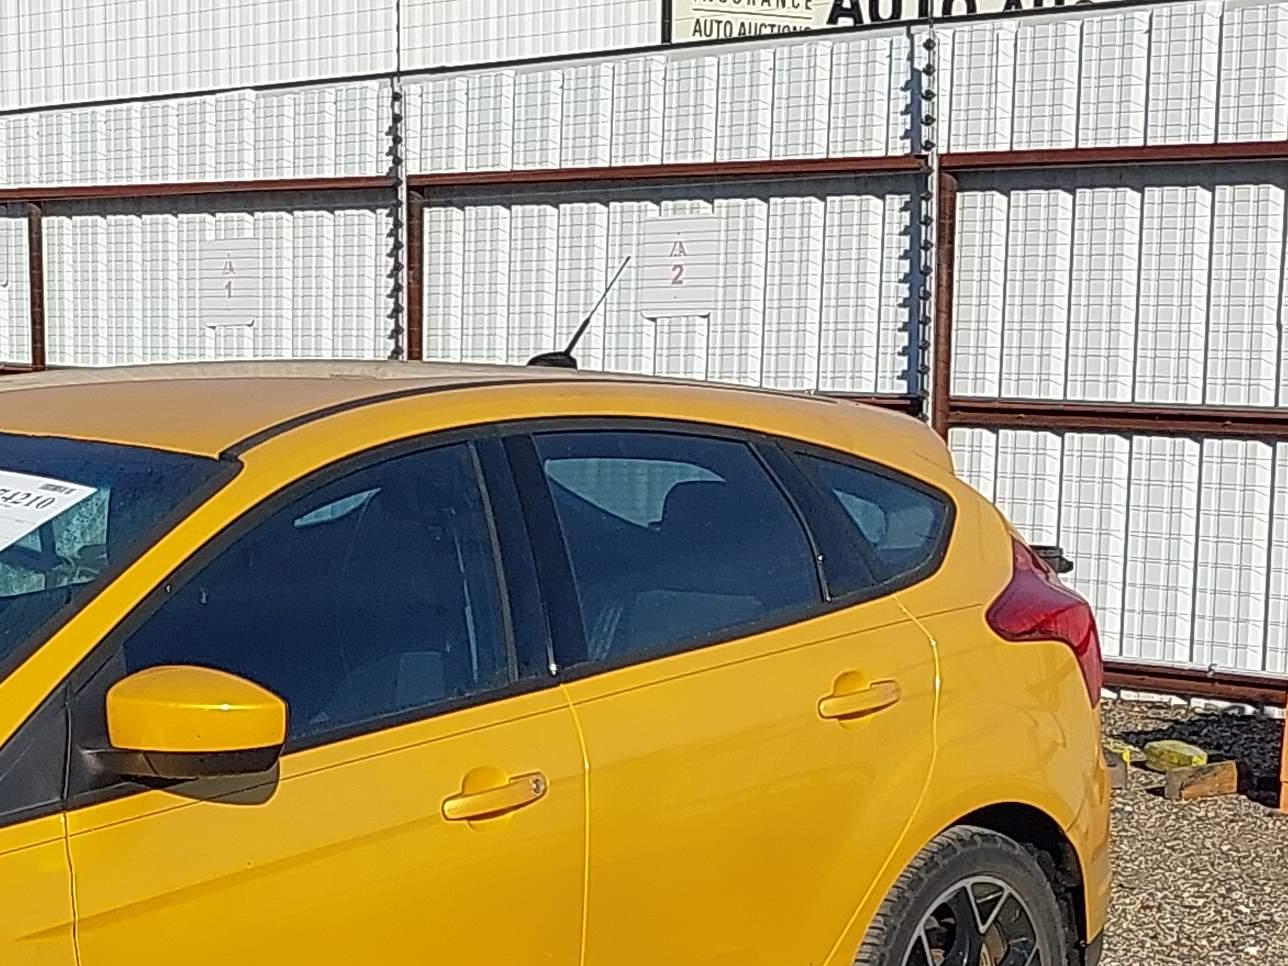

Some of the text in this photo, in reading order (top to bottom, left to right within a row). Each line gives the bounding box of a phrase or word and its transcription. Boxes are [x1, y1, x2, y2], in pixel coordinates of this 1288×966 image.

[692, 18, 733, 39] AUTO
[672, 264, 684, 285] 2
[225, 280, 232, 299] 1
